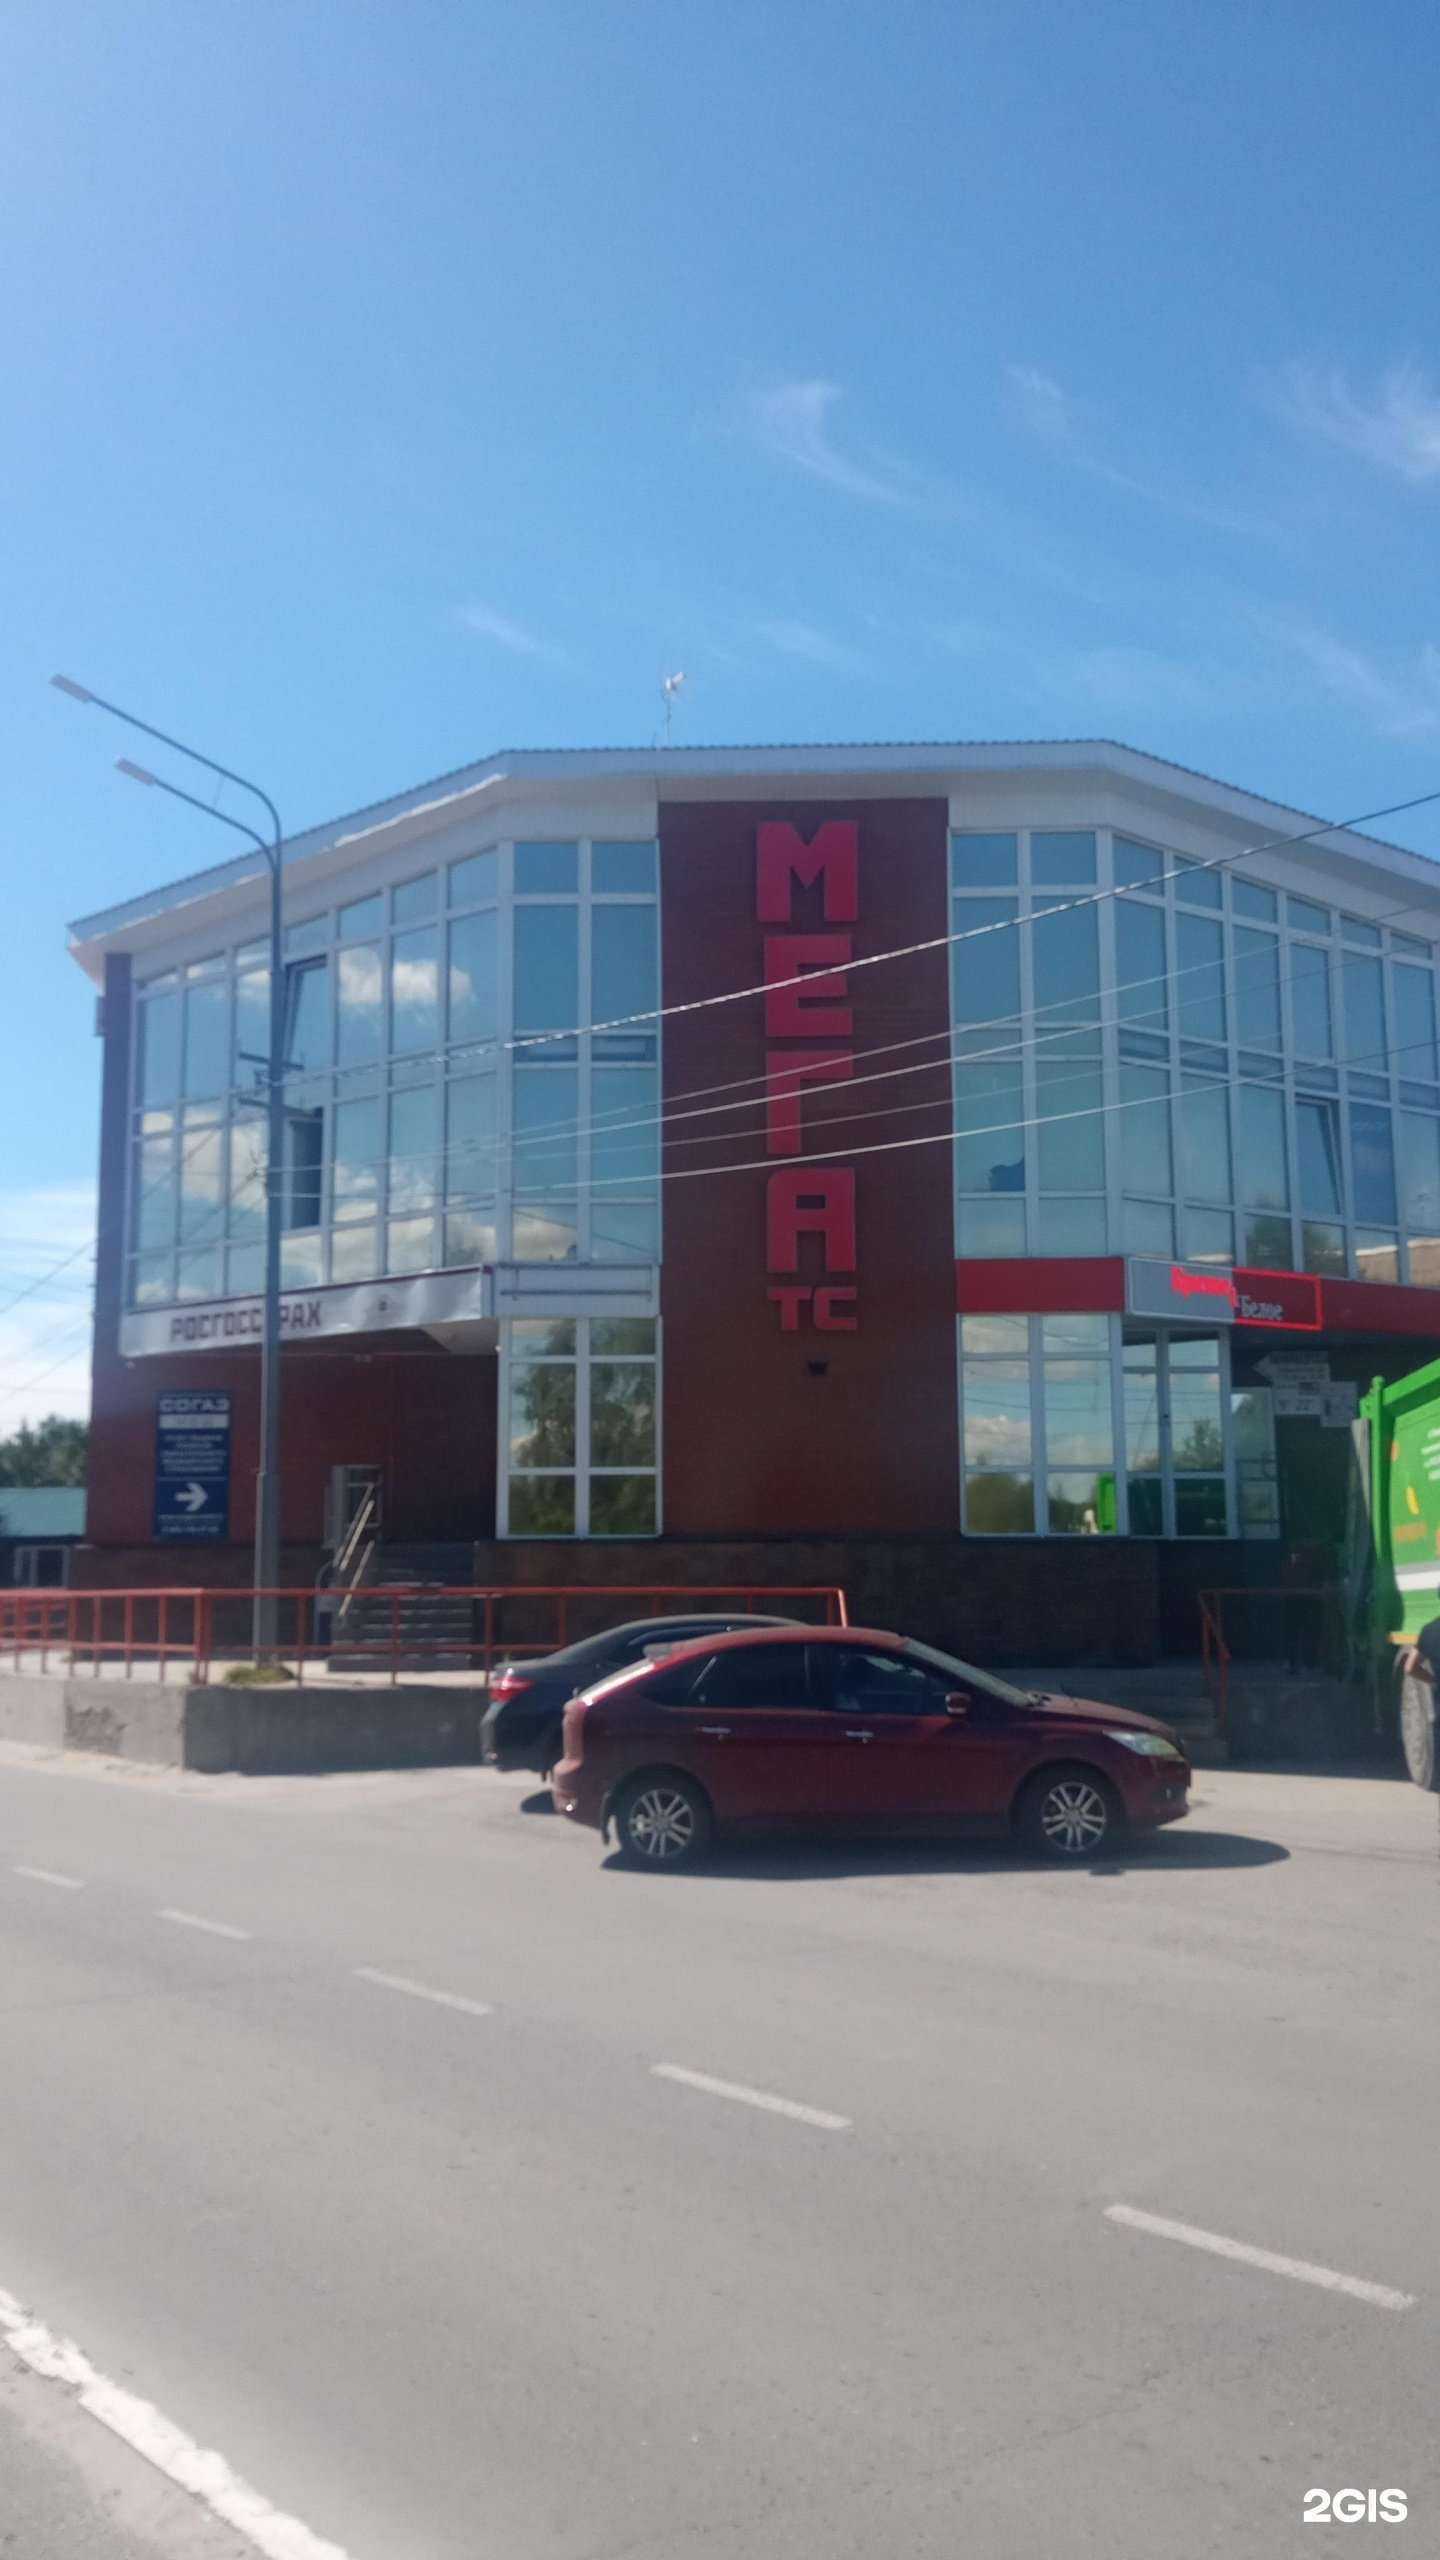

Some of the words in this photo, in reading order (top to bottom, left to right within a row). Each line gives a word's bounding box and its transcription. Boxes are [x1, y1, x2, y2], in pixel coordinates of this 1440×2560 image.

[756, 820, 859, 1273] МЕГА
[170, 1301, 322, 1343] РОСГОССРАХ
[767, 1286, 858, 1331] ТС
[160, 1398, 230, 1412] СОГАЗ
